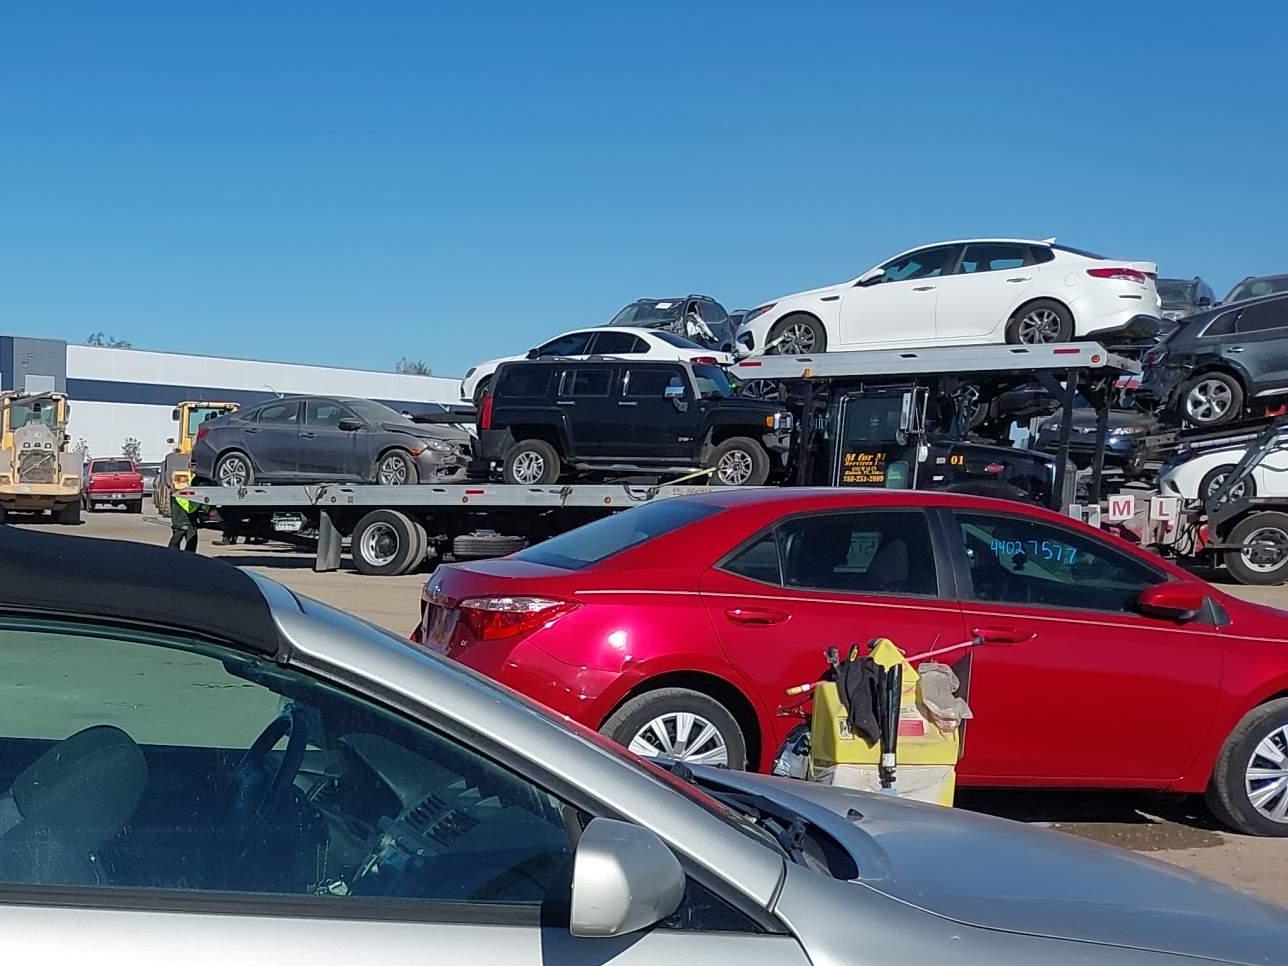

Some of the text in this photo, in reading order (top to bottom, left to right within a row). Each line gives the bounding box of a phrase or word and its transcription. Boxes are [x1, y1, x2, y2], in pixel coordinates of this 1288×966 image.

[844, 453, 857, 461] M
[858, 453, 874, 461] for
[951, 455, 964, 465] 01
[1112, 500, 1131, 517] M
[1158, 500, 1170, 517] L
[990, 540, 1077, 565] 44027577
